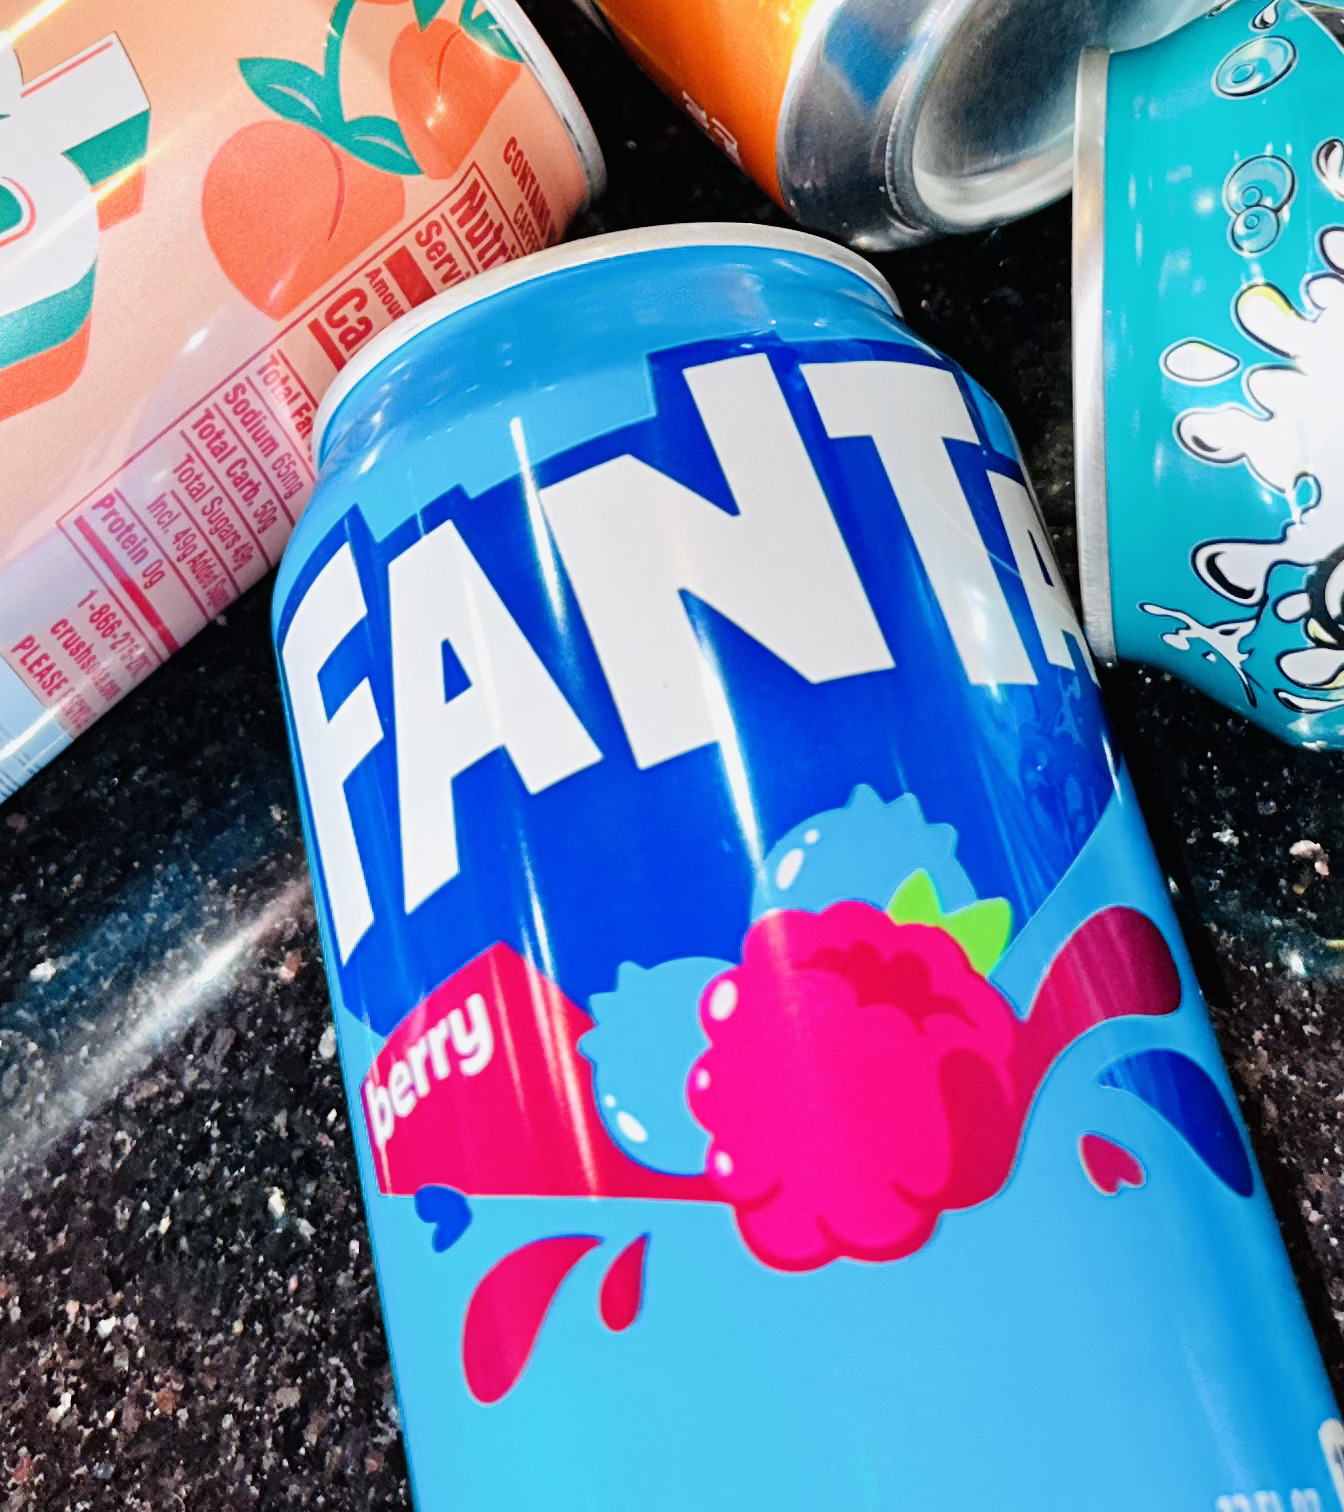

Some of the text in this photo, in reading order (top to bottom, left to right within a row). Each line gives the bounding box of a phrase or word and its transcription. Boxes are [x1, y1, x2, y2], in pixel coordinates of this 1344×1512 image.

[414, 220, 471, 286] Servi
[256, 354, 294, 404] Total
[190, 406, 235, 466] Total
[227, 454, 264, 508] Carb.
[223, 382, 305, 500] Sodium 65mg
[90, 492, 150, 567] Protein
[141, 559, 167, 591] 0g
[145, 492, 173, 530] Incl.
[171, 527, 193, 562] 49g
[171, 453, 213, 503] Total
[201, 496, 242, 550] Sugars
[10, 633, 70, 700] PLEASE
[282, 351, 1100, 966] FANTA
[364, 990, 495, 1143] berry
